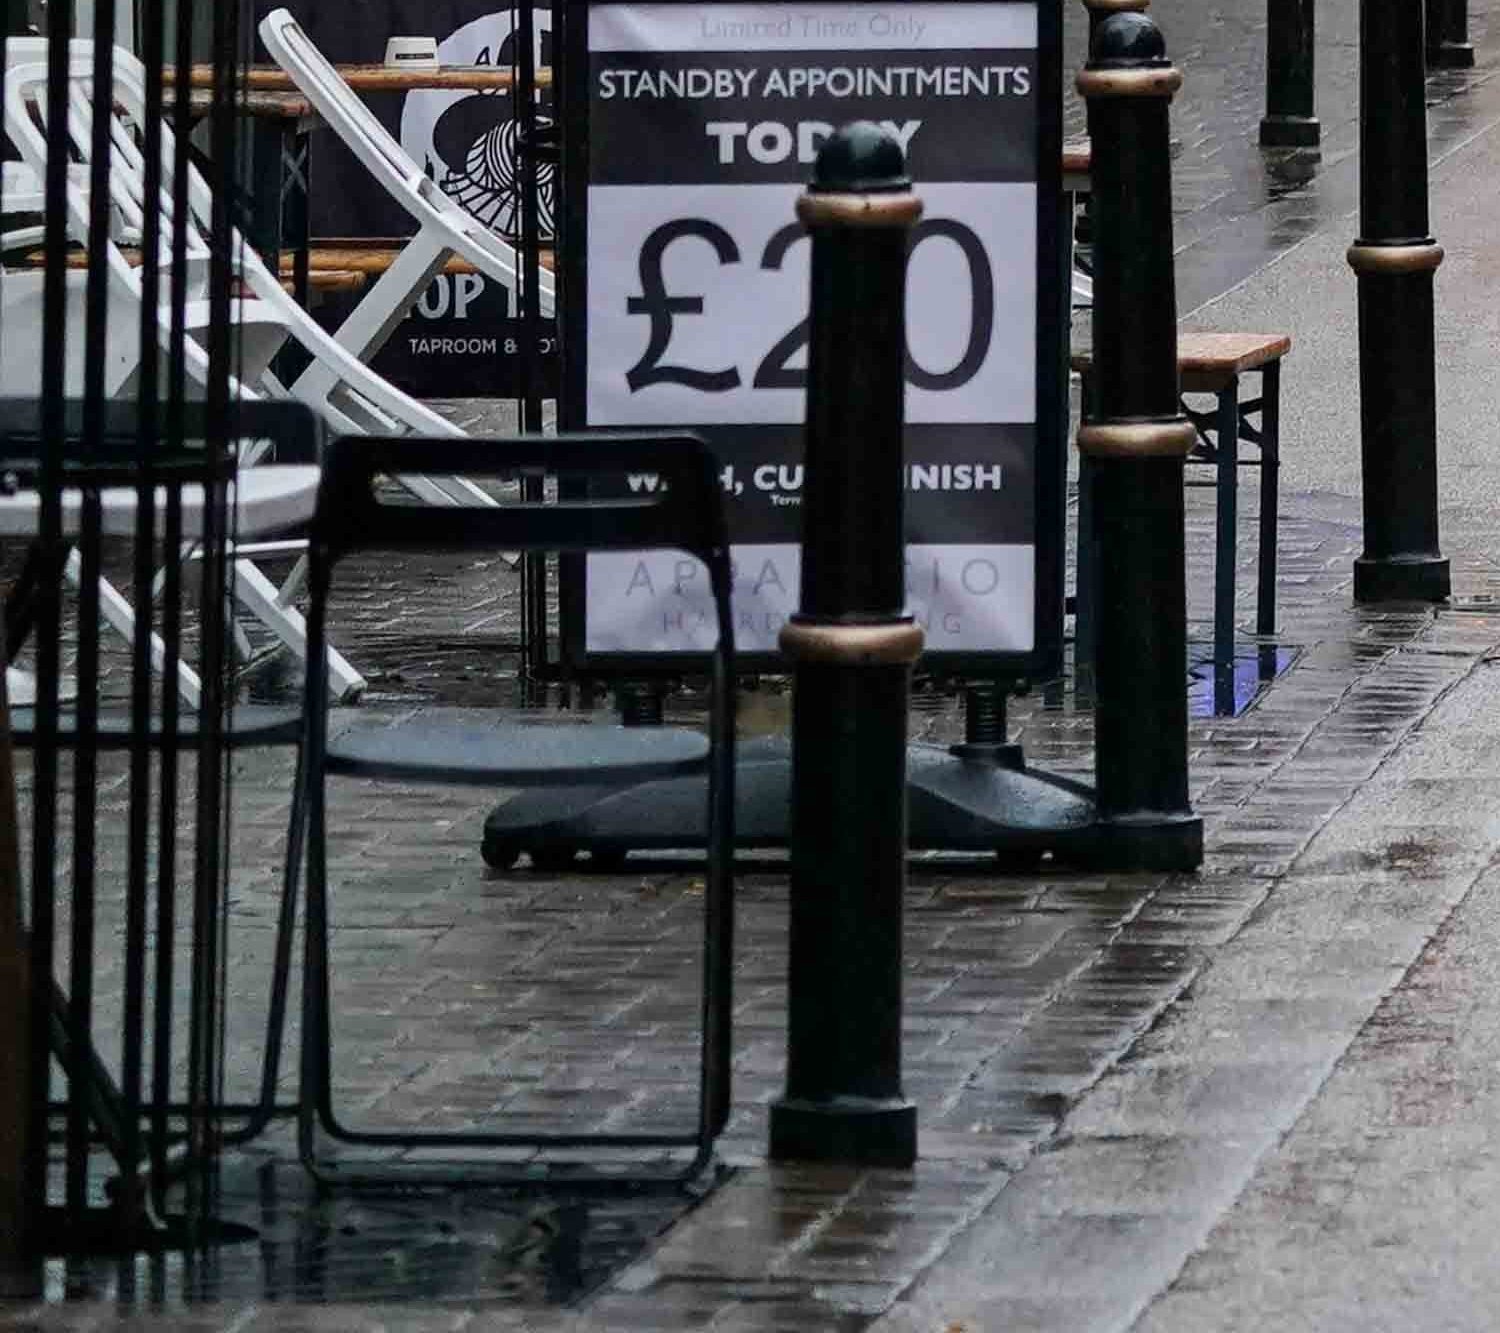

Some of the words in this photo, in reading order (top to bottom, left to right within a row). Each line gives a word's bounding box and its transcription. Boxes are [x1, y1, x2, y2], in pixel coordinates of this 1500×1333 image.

[701, 14, 792, 38] Limited
[796, 14, 858, 38] Time
[868, 13, 927, 43] Only
[600, 69, 755, 100] STANDBY
[762, 66, 1031, 98] APPOINTMENTS
[706, 119, 924, 164] TODY
[409, 338, 498, 354] TAPROOM
[753, 465, 806, 491] CU
[902, 465, 1002, 491] NISH
